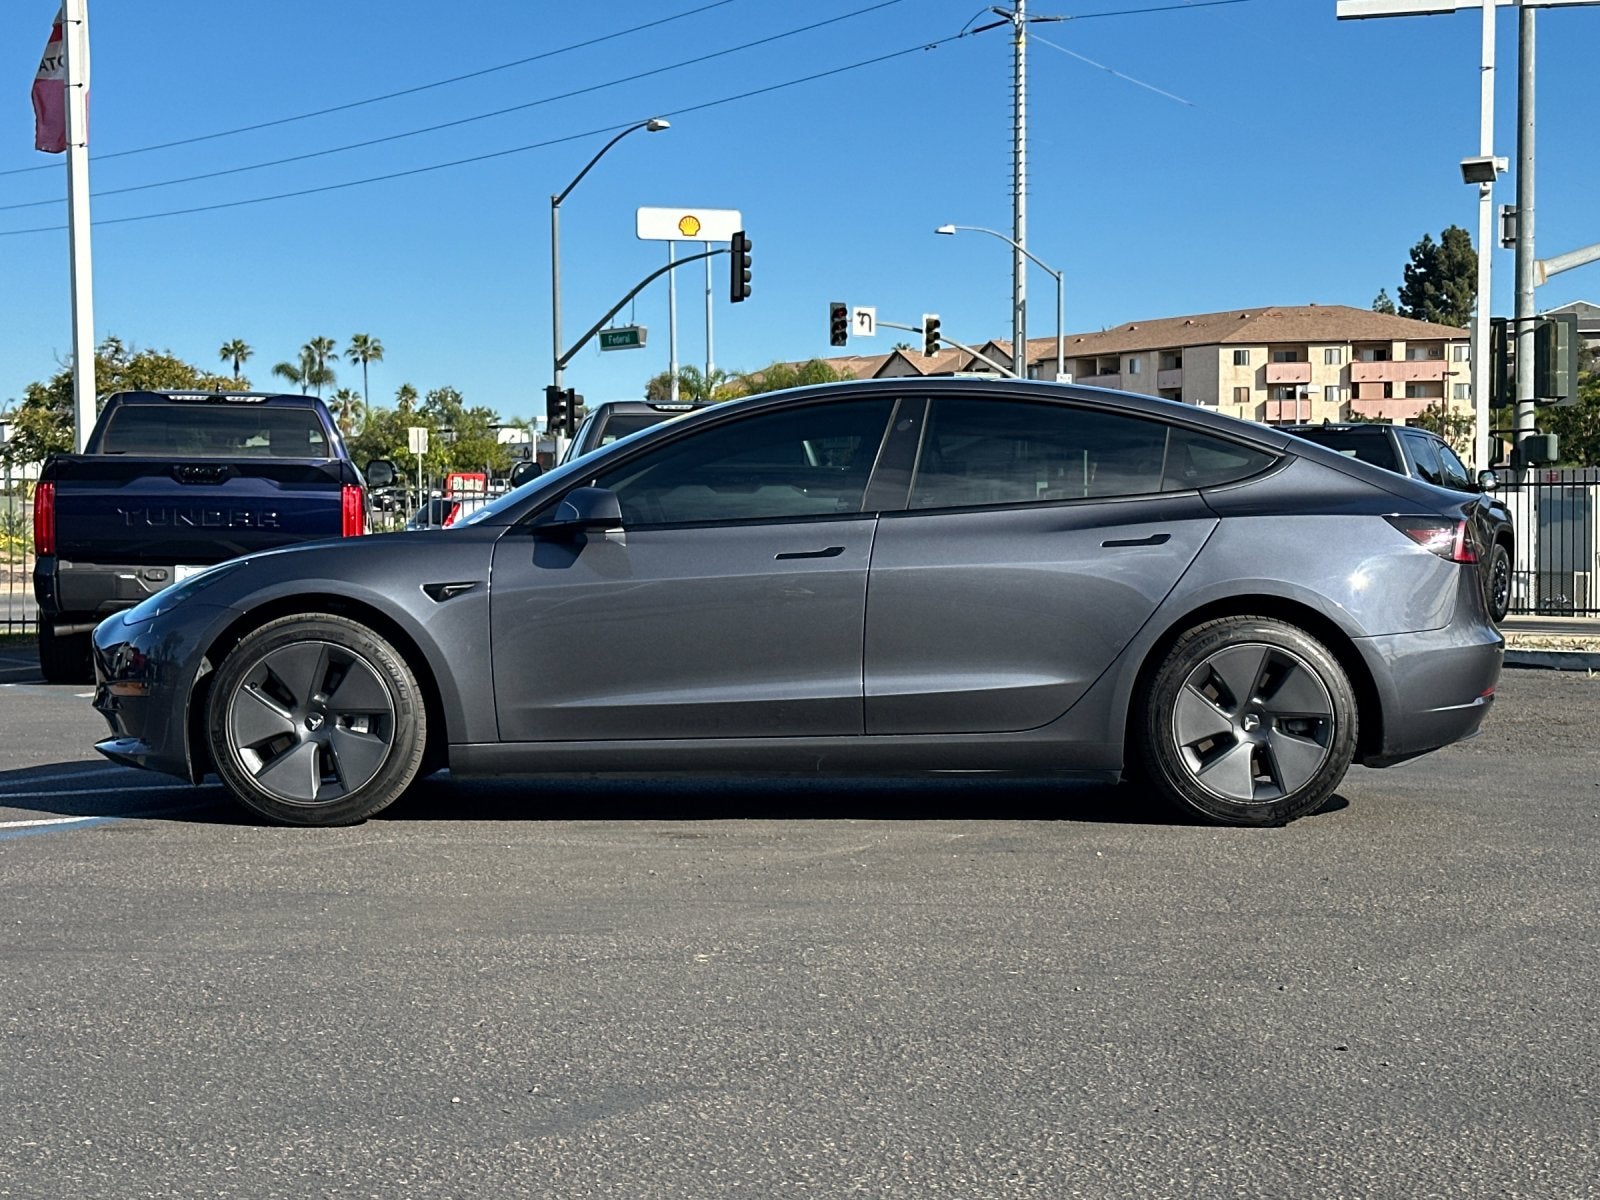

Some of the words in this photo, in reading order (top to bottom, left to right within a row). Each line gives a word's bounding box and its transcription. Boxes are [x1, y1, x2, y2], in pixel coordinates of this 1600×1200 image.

[608, 334, 631, 345] Federal
[117, 507, 280, 528] TUNDRA
[375, 649, 409, 700] MICHELIN
